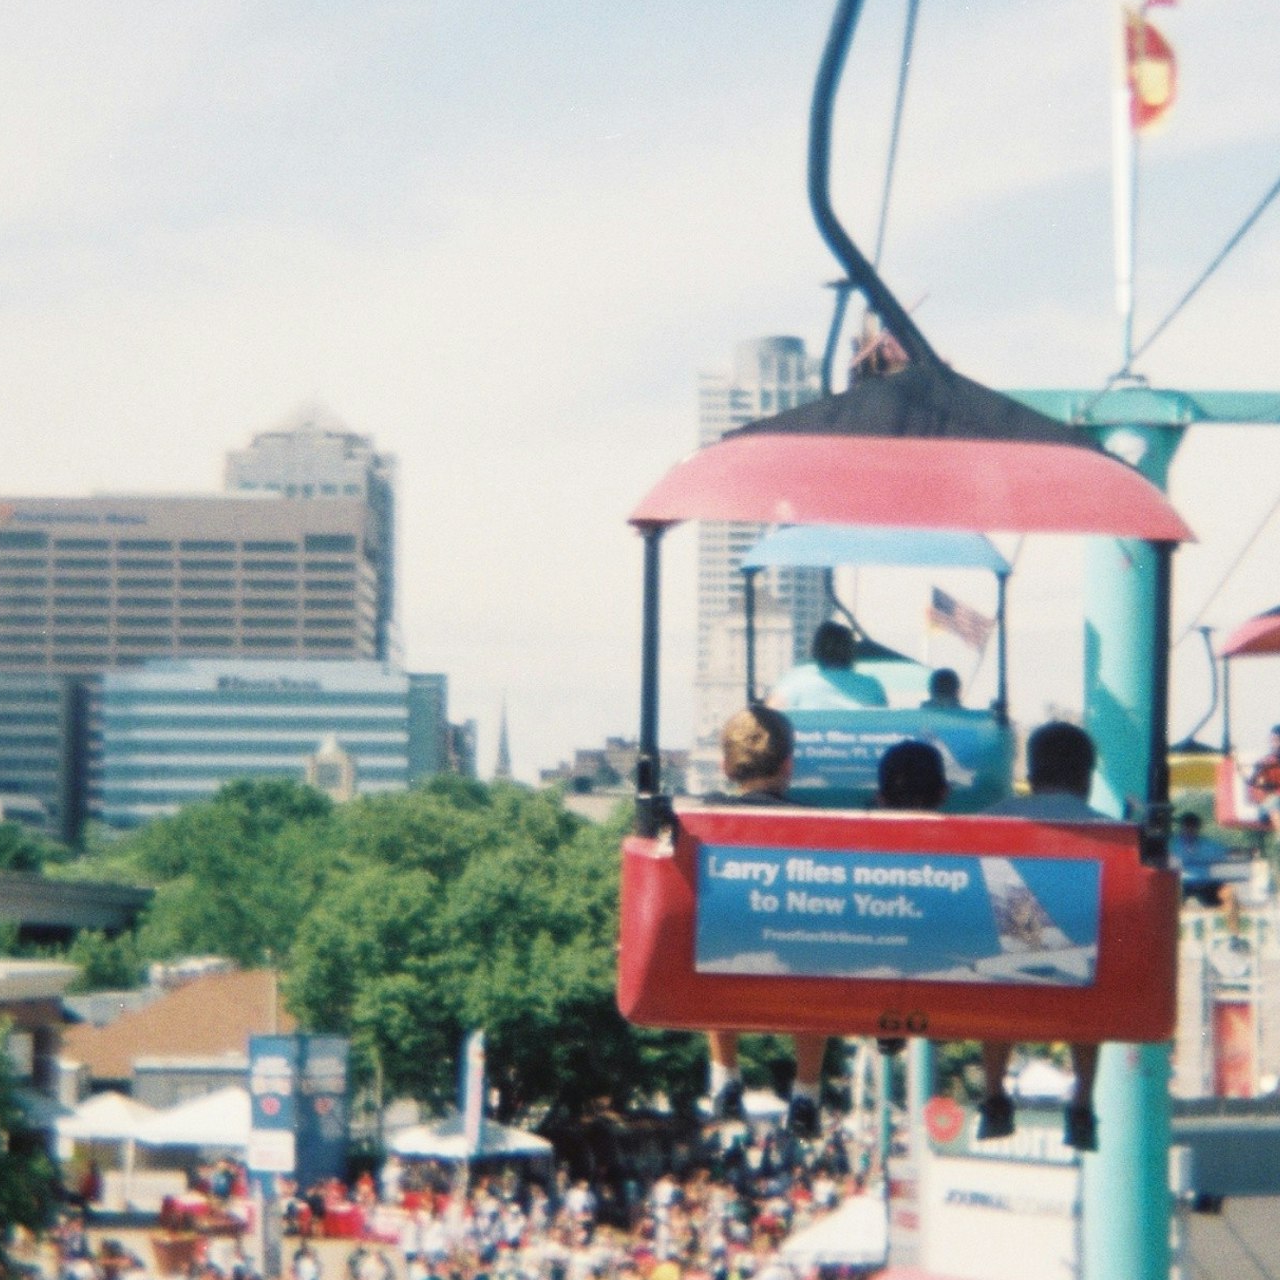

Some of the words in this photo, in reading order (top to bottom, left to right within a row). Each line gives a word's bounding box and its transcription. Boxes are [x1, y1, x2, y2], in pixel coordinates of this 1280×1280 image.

[708, 855, 780, 886] Larry
[785, 858, 847, 884] flies
[853, 864, 969, 893] nonstop
[749, 889, 780, 913] to
[786, 891, 847, 915] New
[853, 892, 923, 919] York.
